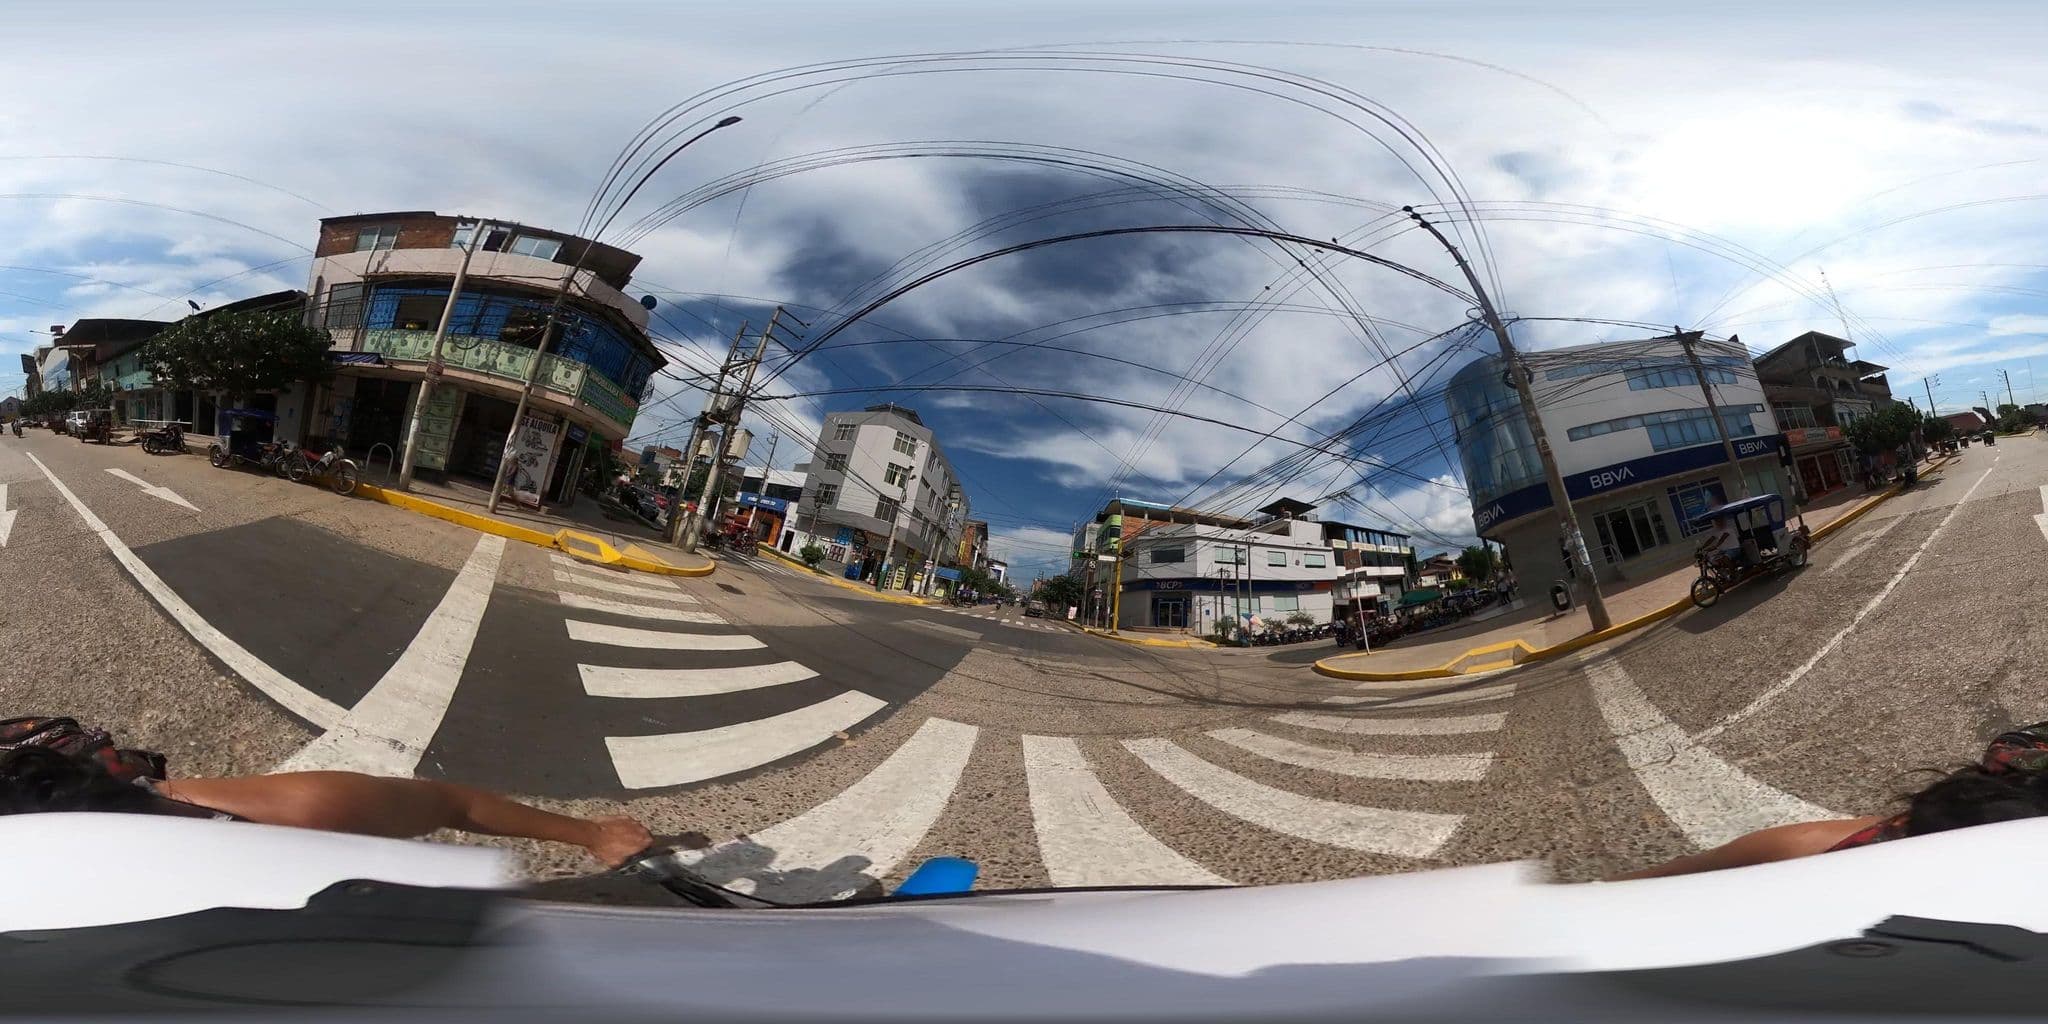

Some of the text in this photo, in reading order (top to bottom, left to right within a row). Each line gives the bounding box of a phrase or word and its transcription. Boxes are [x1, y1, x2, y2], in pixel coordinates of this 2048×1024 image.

[521, 416, 530, 427] SE
[530, 418, 558, 434] ALQUILA
[1739, 440, 1767, 455] BBVA
[1589, 466, 1634, 489] BBVA
[1479, 504, 1504, 527] BBVA
[1160, 581, 1178, 590] BCP
